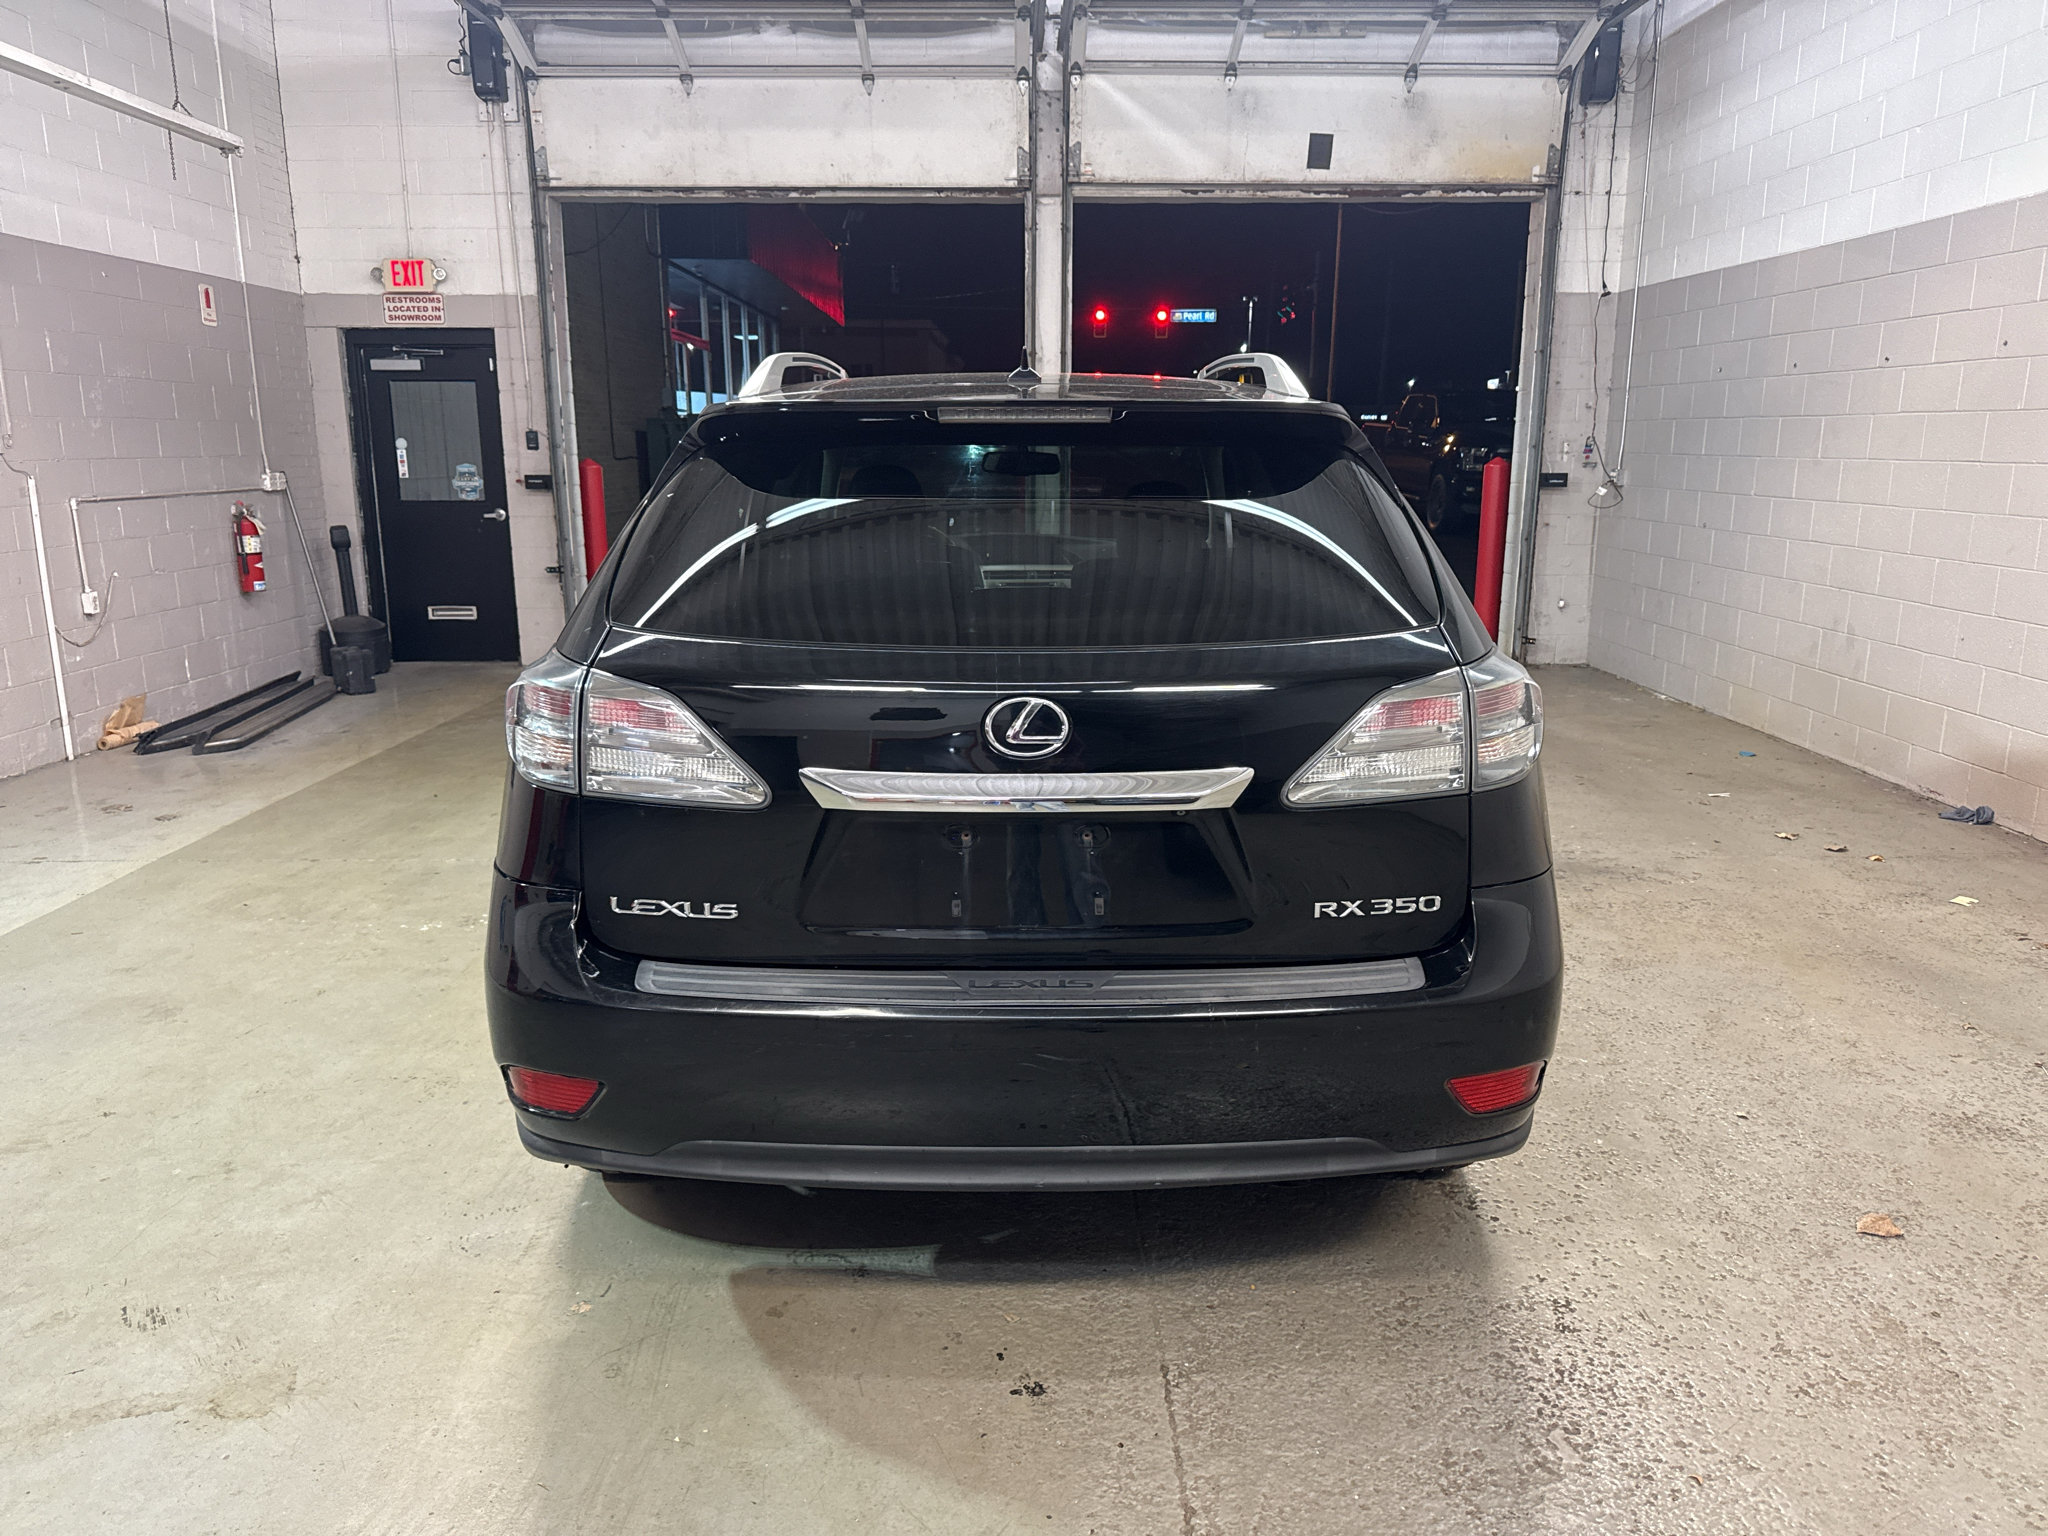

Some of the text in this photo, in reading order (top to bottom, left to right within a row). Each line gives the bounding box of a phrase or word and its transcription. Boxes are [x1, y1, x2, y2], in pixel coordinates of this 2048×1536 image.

[390, 260, 424, 287] EXIT
[385, 296, 442, 304] RESTROOMS
[387, 305, 441, 313] LOCATED IN
[388, 314, 442, 322] SHOWROOM
[1183, 311, 1202, 321] Pearl
[1204, 311, 1215, 321] Rd
[609, 896, 739, 920] LEXUS
[1313, 895, 1442, 919] RX 350
[968, 979, 1094, 989] LEXUS
